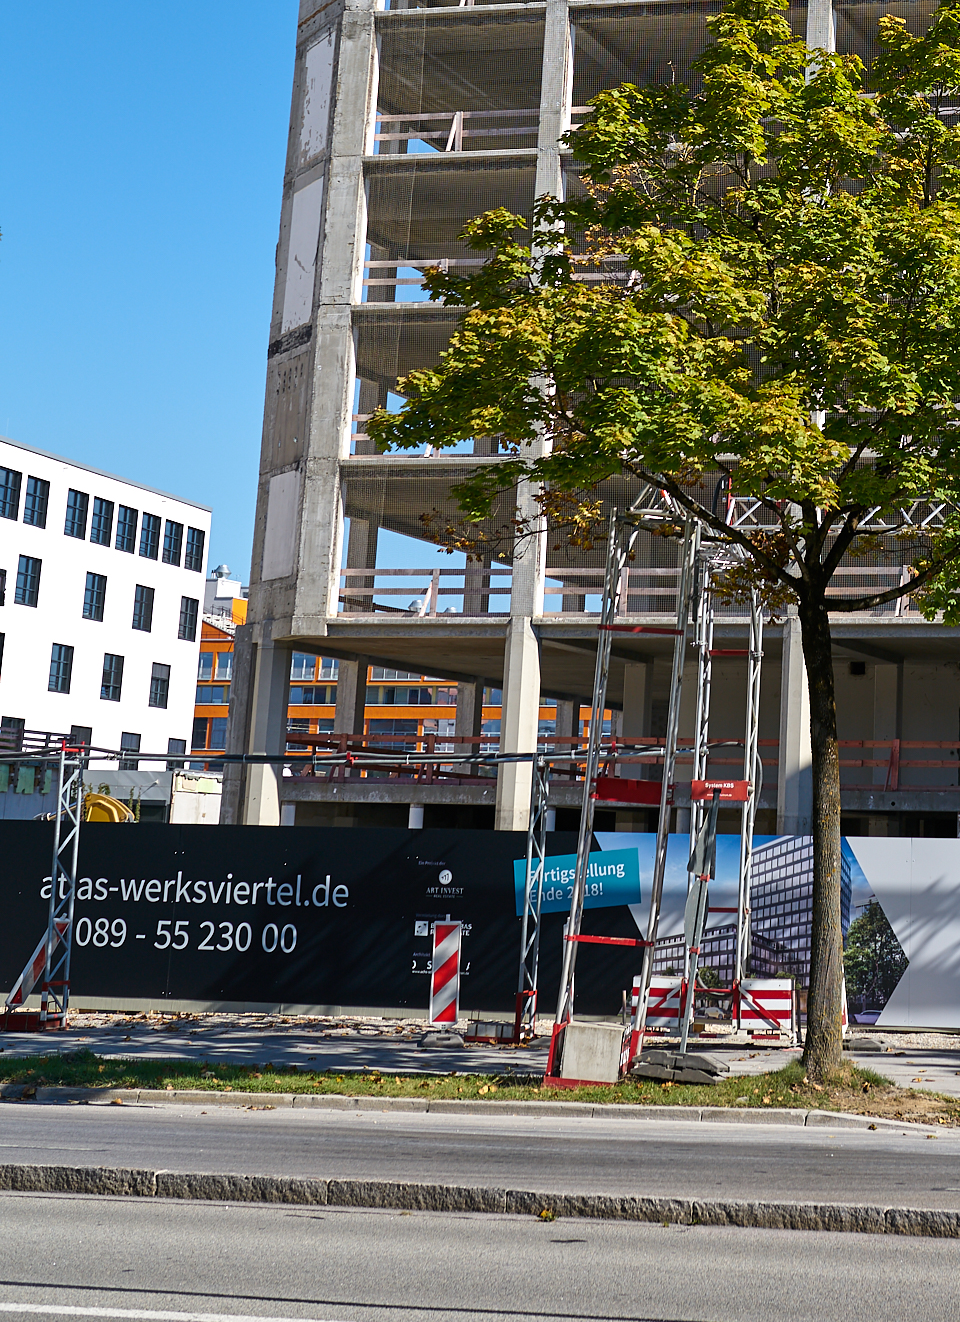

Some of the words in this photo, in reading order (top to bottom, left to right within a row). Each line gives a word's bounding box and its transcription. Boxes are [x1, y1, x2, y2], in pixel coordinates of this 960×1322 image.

[39, 870, 350, 908] atas-werksviertel.de
[440, 887, 465, 895] INVEST
[566, 881, 604, 899] 218!
[75, 917, 127, 948] 089
[153, 920, 190, 950] 55
[197, 921, 252, 952] 230
[261, 923, 298, 954] 00
